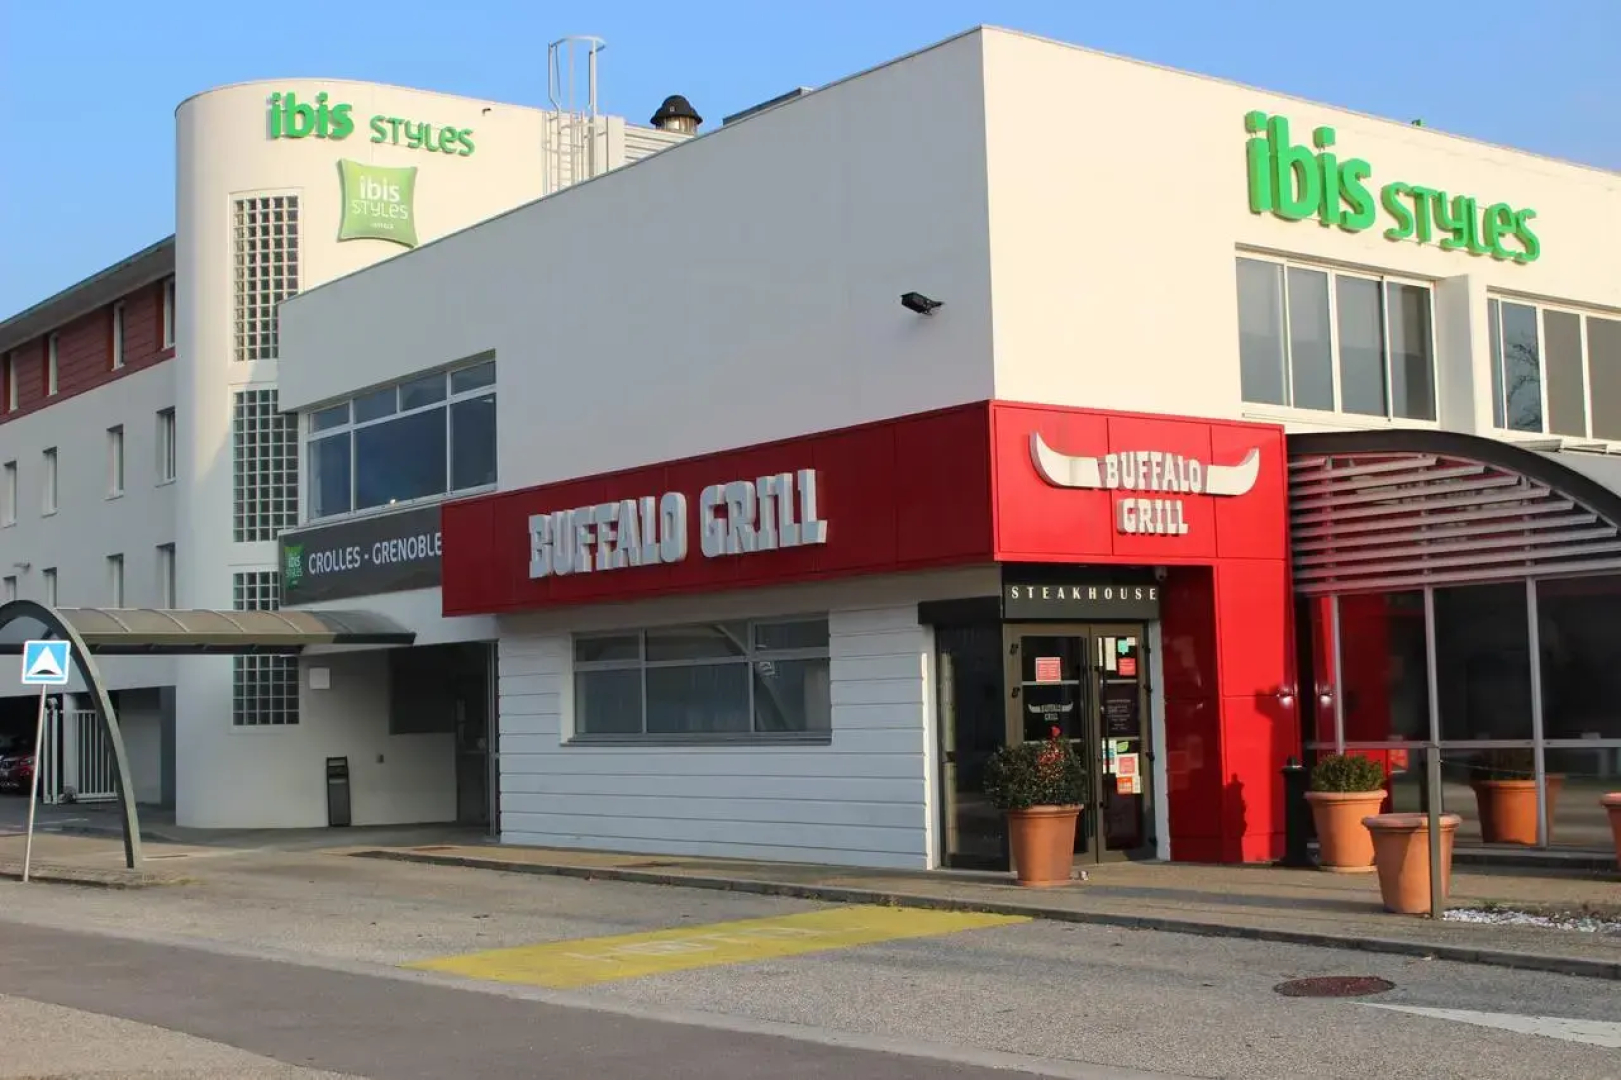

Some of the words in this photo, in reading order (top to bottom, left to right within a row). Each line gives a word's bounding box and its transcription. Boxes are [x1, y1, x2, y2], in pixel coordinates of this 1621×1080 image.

[266, 92, 354, 139] ibis
[360, 175, 401, 203] ibis
[1245, 110, 1376, 233] ibis
[1102, 450, 1204, 494] BUFFALO
[528, 491, 688, 579] BUFFALO
[700, 469, 828, 558] GRILL
[1117, 498, 1190, 535] GRILL
[308, 546, 361, 575] CROLLES
[372, 532, 442, 565] GRENOBLE
[1011, 586, 1156, 600] STEAKHOUSE
